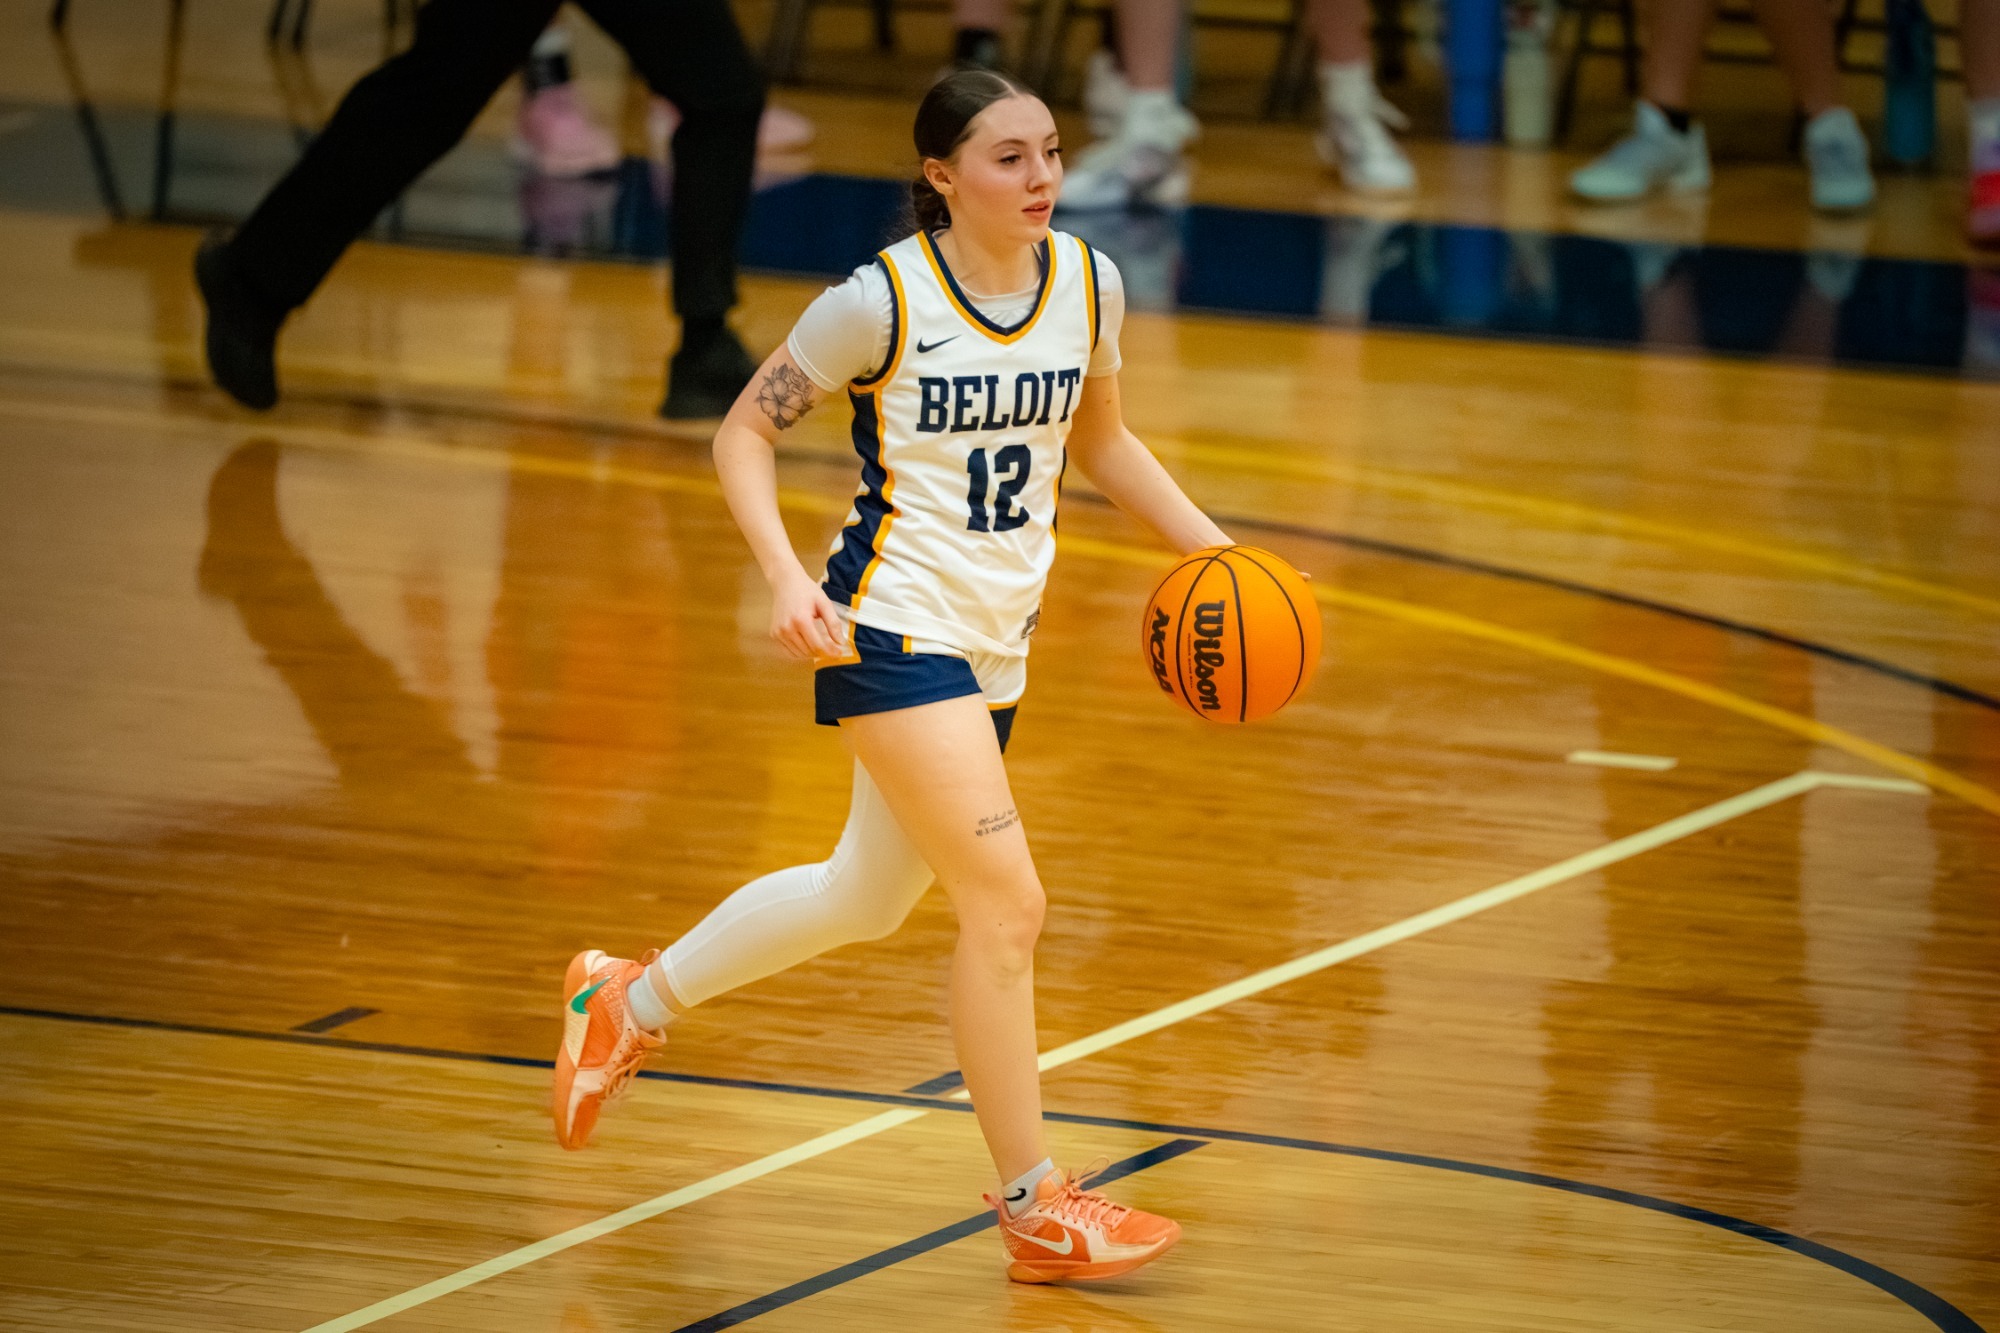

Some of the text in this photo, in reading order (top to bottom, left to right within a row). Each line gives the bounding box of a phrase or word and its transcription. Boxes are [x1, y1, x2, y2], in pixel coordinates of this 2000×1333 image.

[916, 367, 1081, 433] BELOIT
[966, 444, 1032, 533] 12
[1151, 606, 1175, 694] NCAA
[1193, 600, 1226, 711] Wilson
